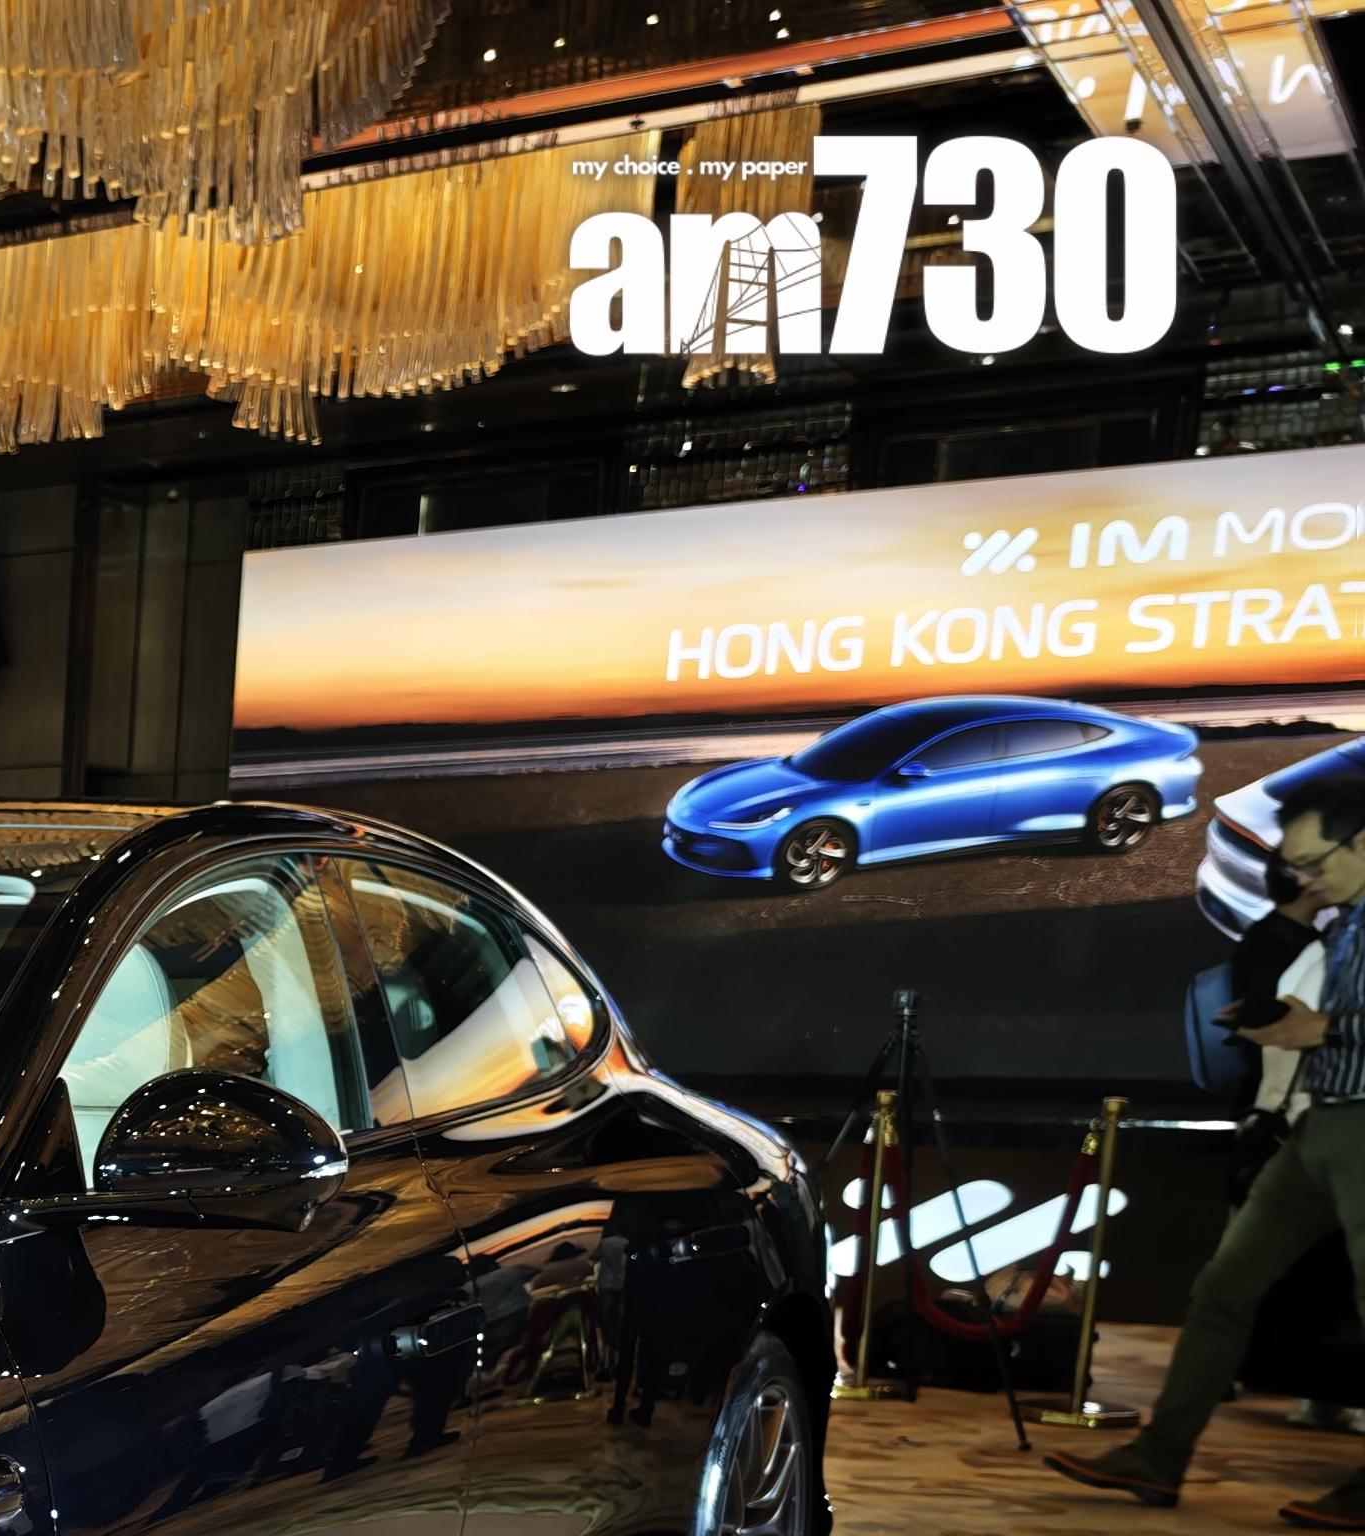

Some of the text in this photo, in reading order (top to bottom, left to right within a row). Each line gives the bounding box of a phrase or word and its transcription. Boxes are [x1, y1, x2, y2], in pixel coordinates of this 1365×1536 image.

[1069, 501, 1365, 569] IM MO
[665, 614, 866, 682] HONG
[890, 598, 1100, 668] KONG
